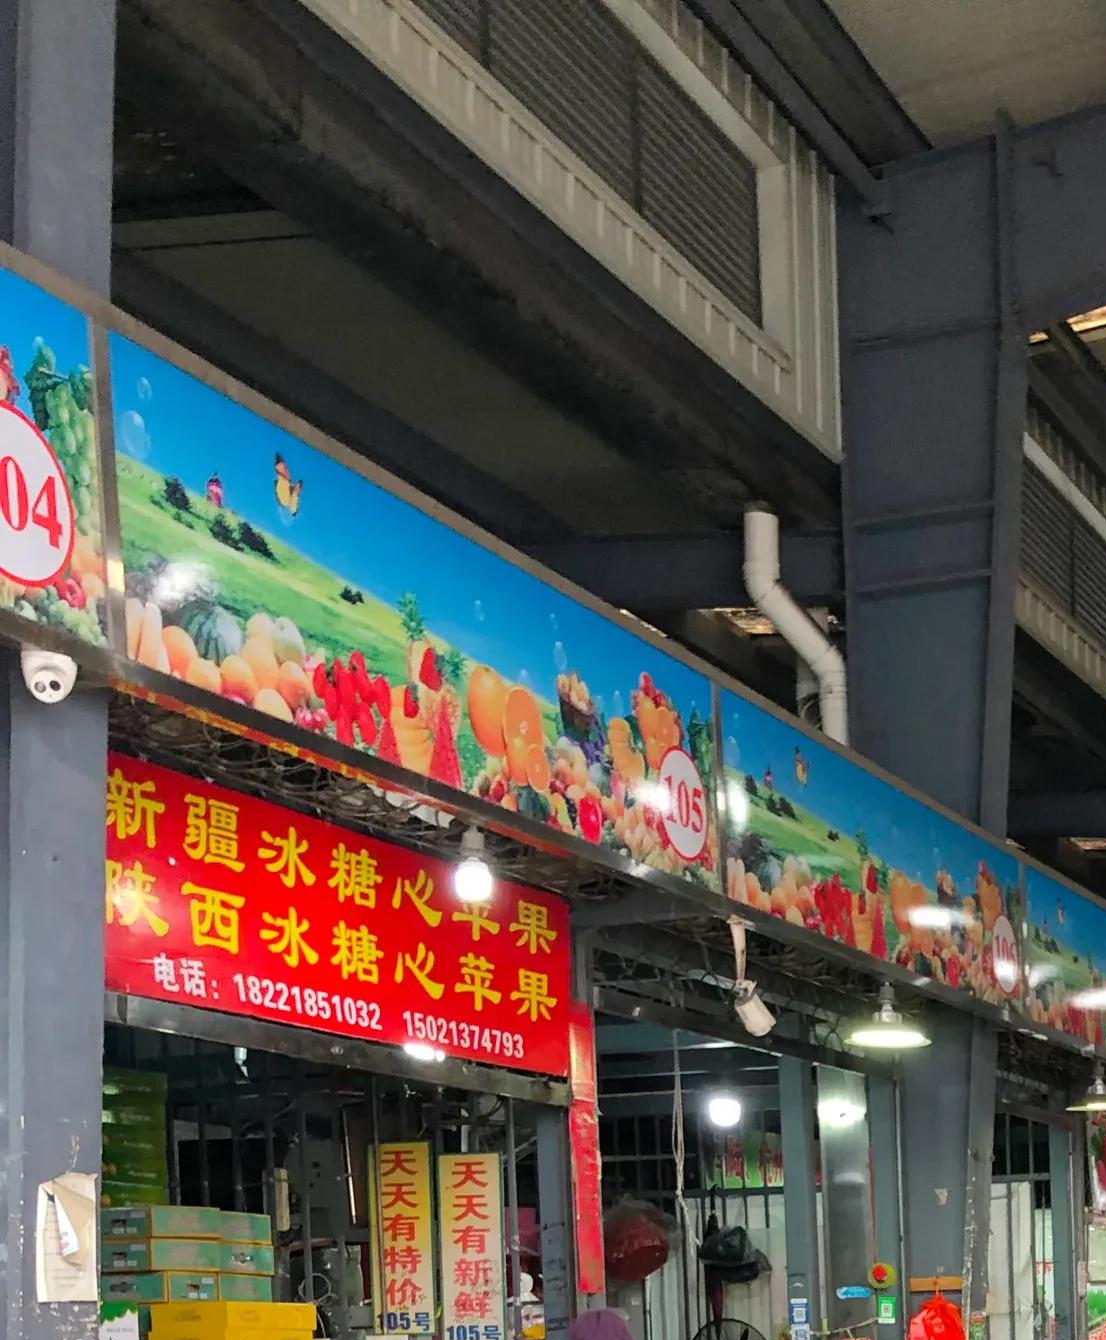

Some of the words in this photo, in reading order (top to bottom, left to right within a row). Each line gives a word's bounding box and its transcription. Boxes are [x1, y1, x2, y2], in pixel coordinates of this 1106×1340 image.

[663, 774, 704, 834] 105
[105, 860, 558, 1022] 陕西冰糖心苹果
[232, 973, 383, 1031] 18221851032
[403, 1010, 524, 1059] 15021374793
[381, 1150, 422, 1306] 天天有特价
[451, 1161, 492, 1319] 天天有新鲜
